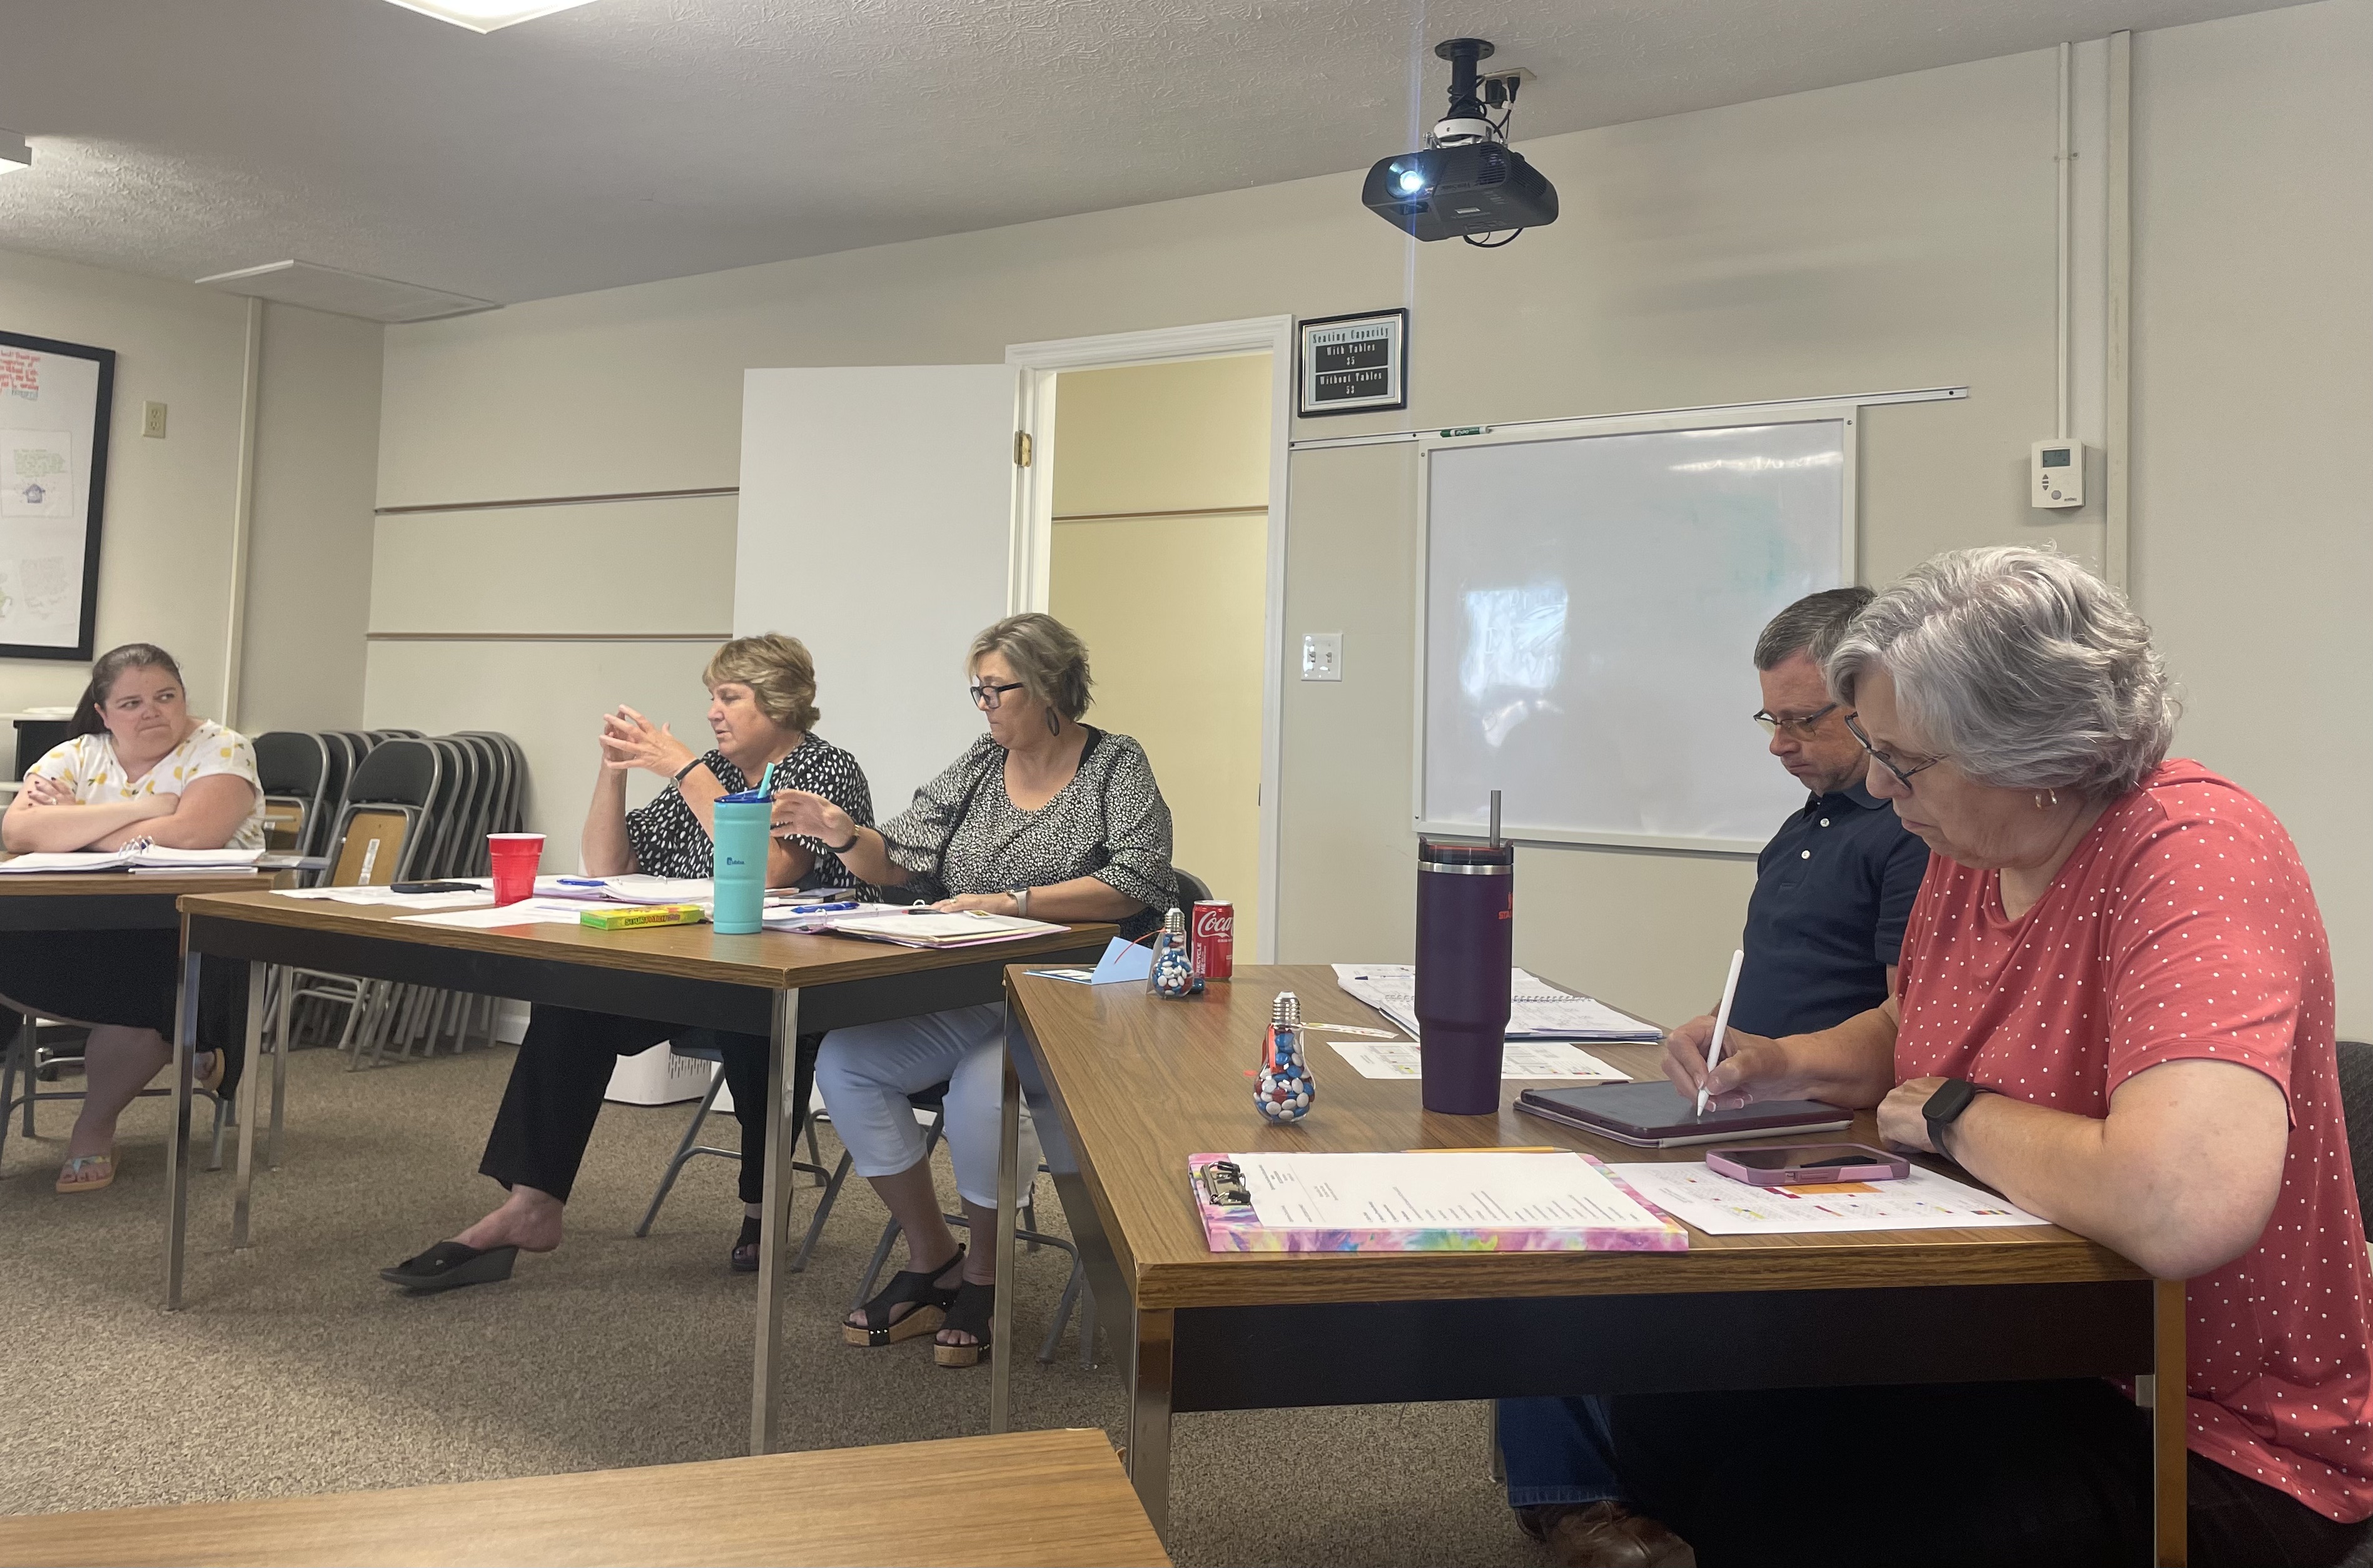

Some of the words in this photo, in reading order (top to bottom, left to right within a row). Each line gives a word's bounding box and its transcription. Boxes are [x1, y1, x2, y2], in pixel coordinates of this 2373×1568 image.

[1313, 331, 1345, 343] Seating
[1351, 326, 1389, 340] Capacity
[1327, 346, 1345, 356] With
[1349, 343, 1375, 353] Tables
[1320, 374, 1351, 385] Without
[1355, 371, 1382, 382] Tables
[1200, 963, 1206, 974] ME
